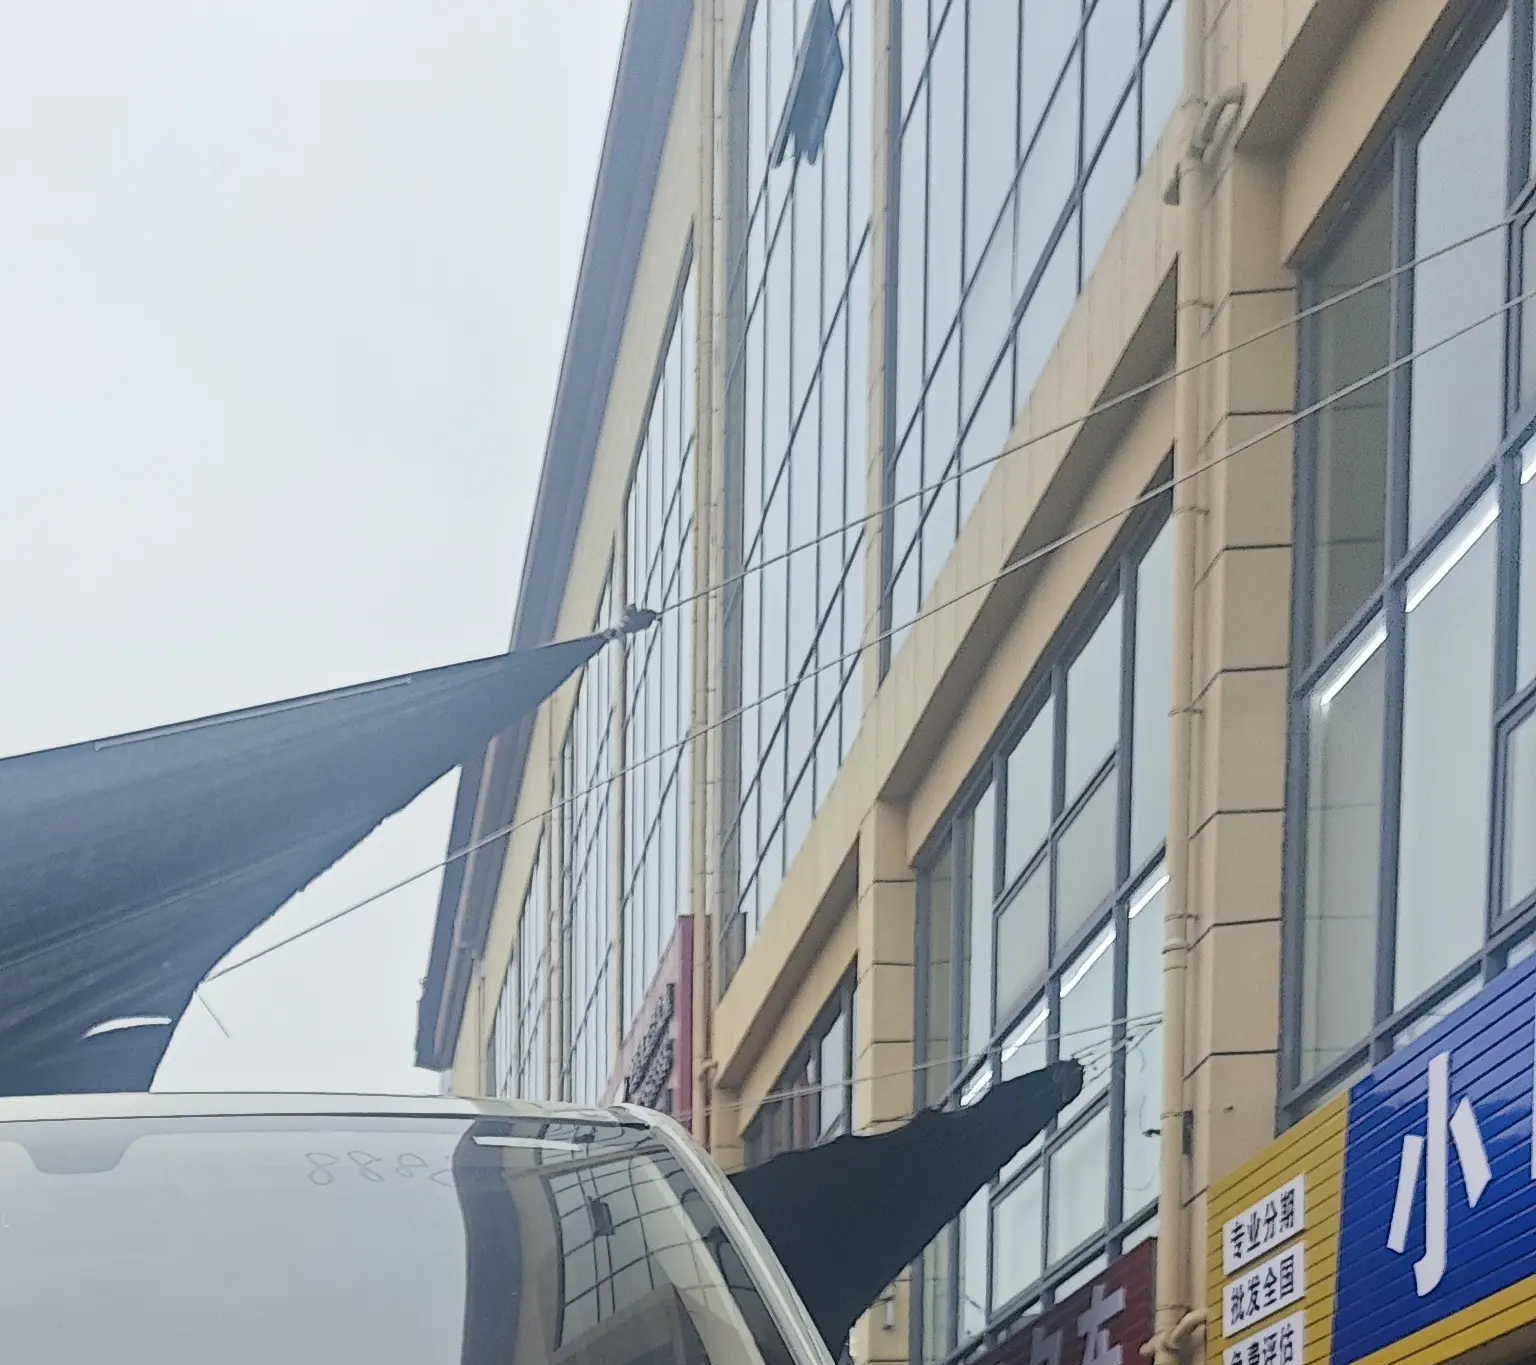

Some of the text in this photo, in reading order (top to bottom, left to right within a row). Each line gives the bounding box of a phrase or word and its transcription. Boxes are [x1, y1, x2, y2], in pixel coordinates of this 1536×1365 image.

[1386, 1002, 1536, 1297] 小
[1230, 1254, 1295, 1325] 批发全国
